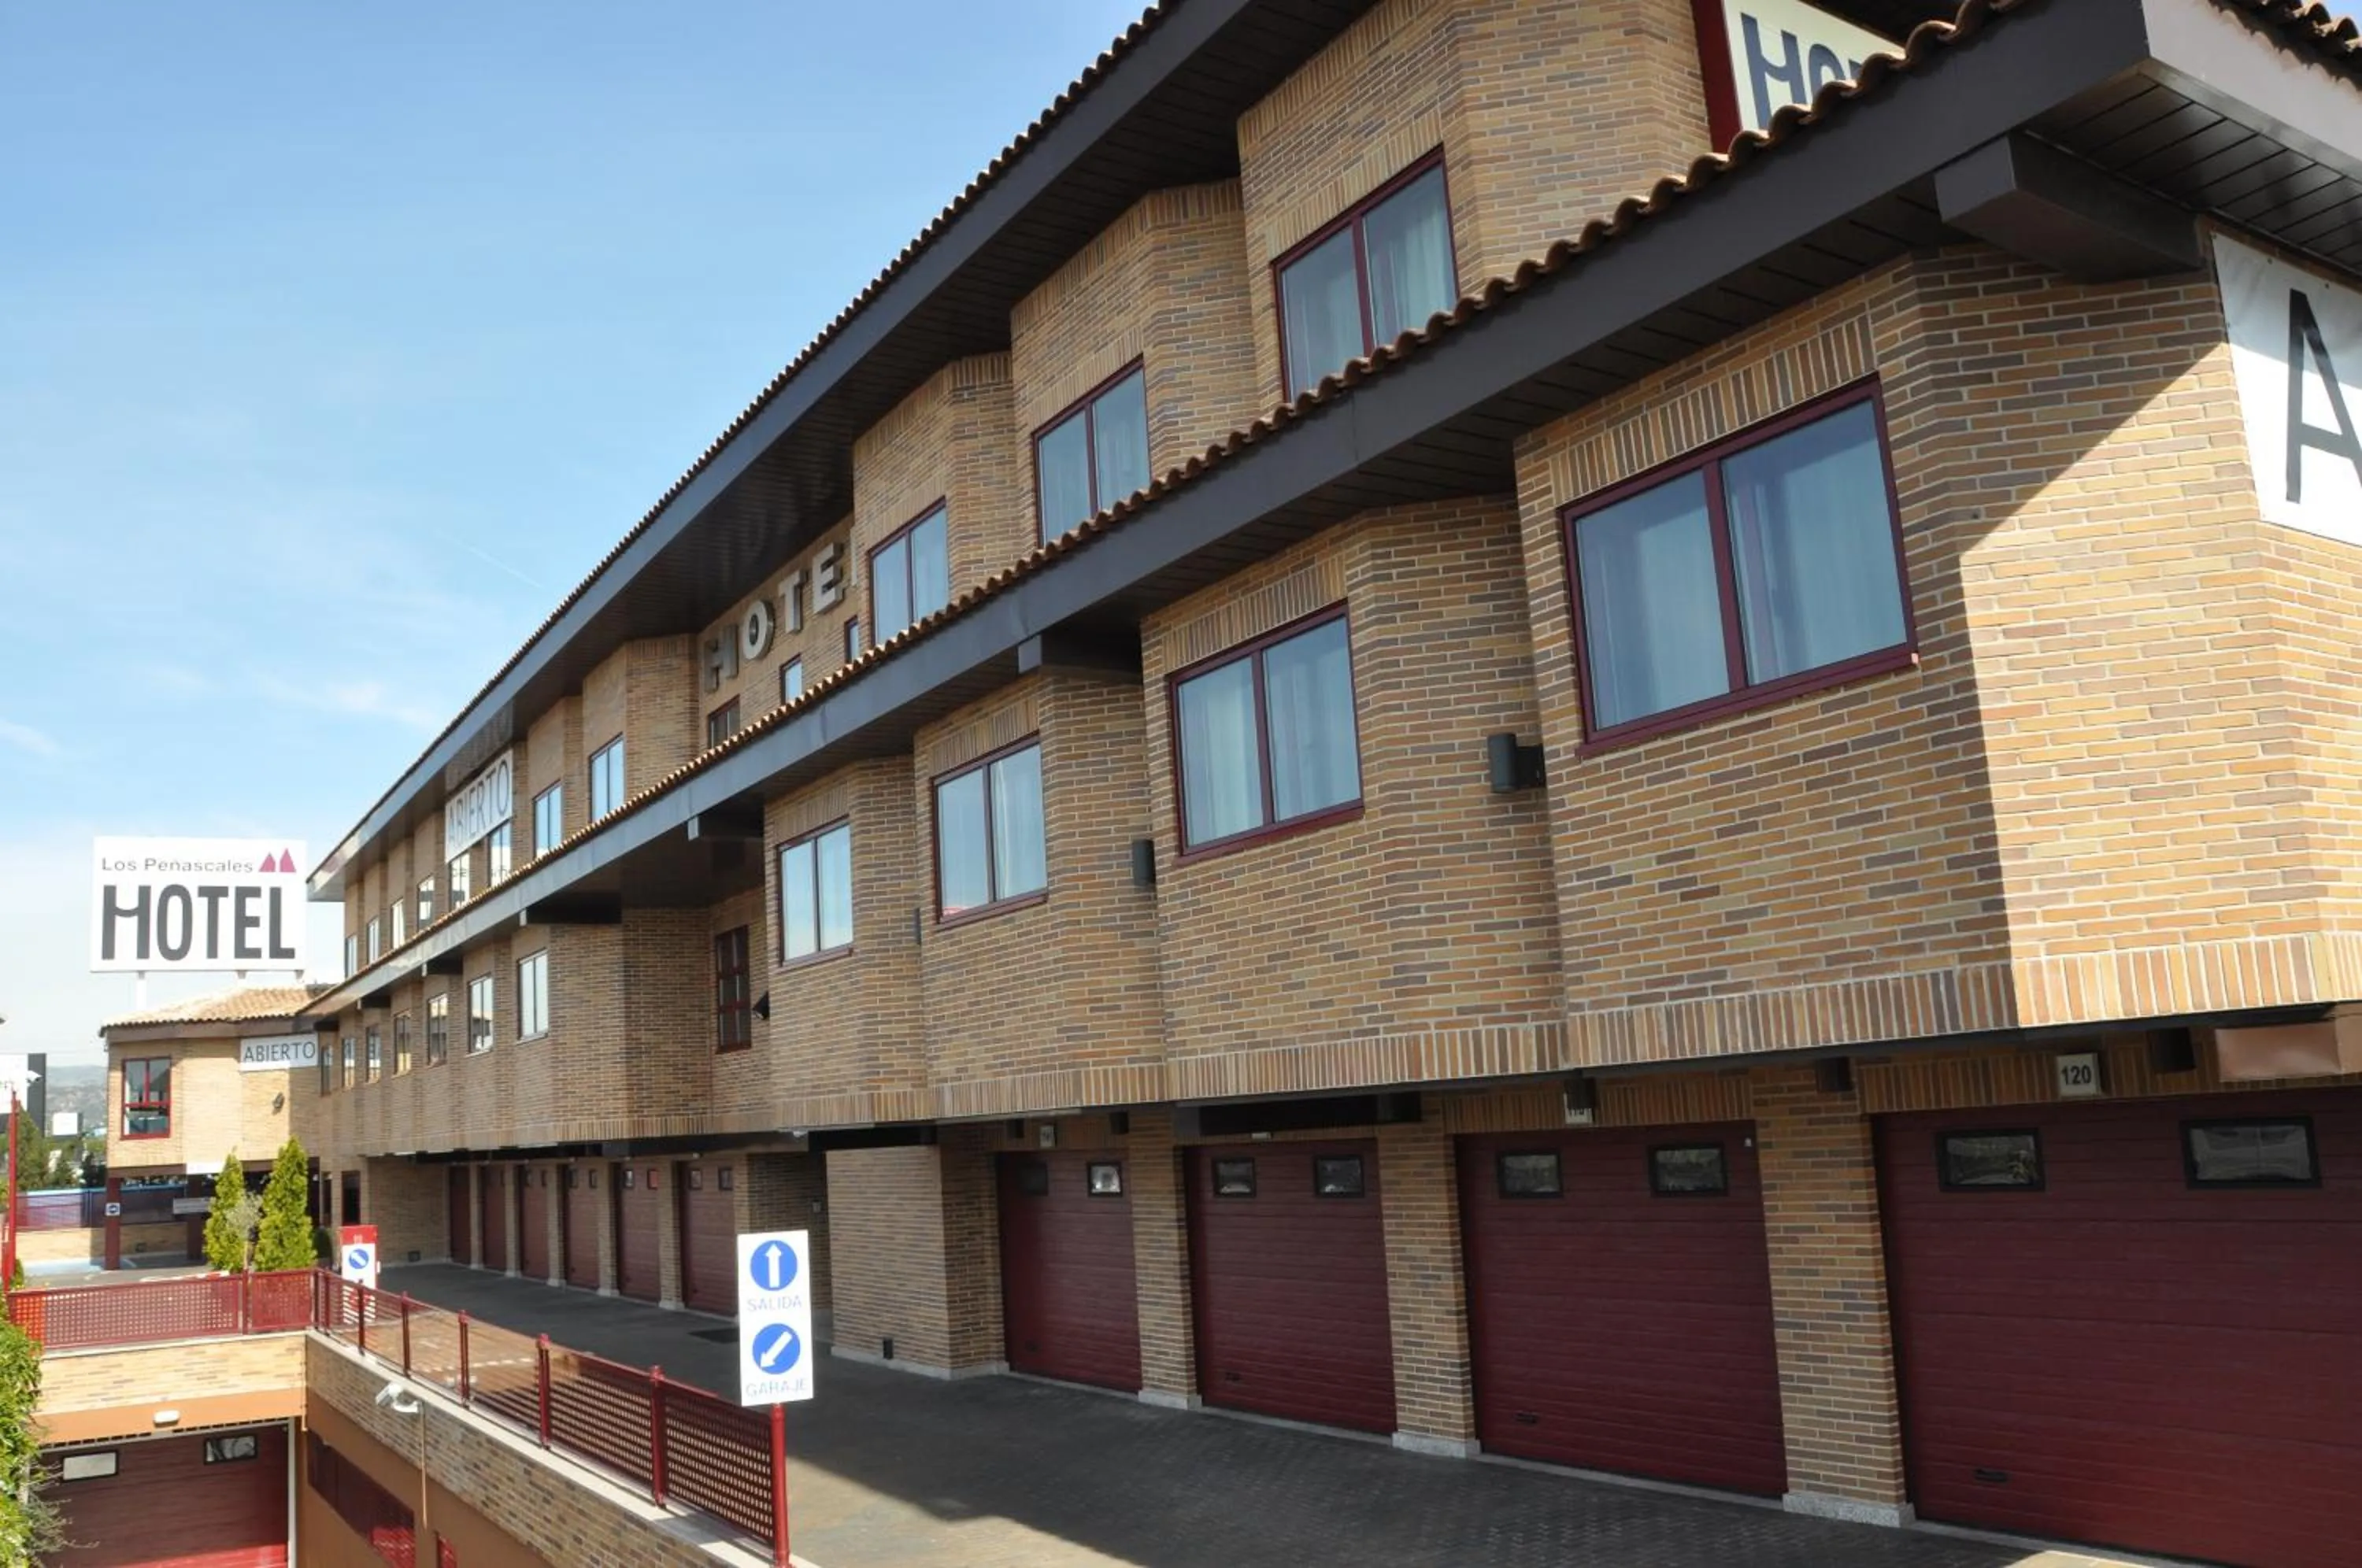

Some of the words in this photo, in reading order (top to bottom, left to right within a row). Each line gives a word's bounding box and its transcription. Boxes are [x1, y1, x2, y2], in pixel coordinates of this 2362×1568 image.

[449, 760, 511, 849] ABIERTO
[102, 857, 137, 871] Los
[101, 883, 297, 962] HOTEL
[244, 1041, 316, 1063] ABIERTO
[2060, 1064, 2092, 1085] 120
[746, 1295, 802, 1313] SALIDA
